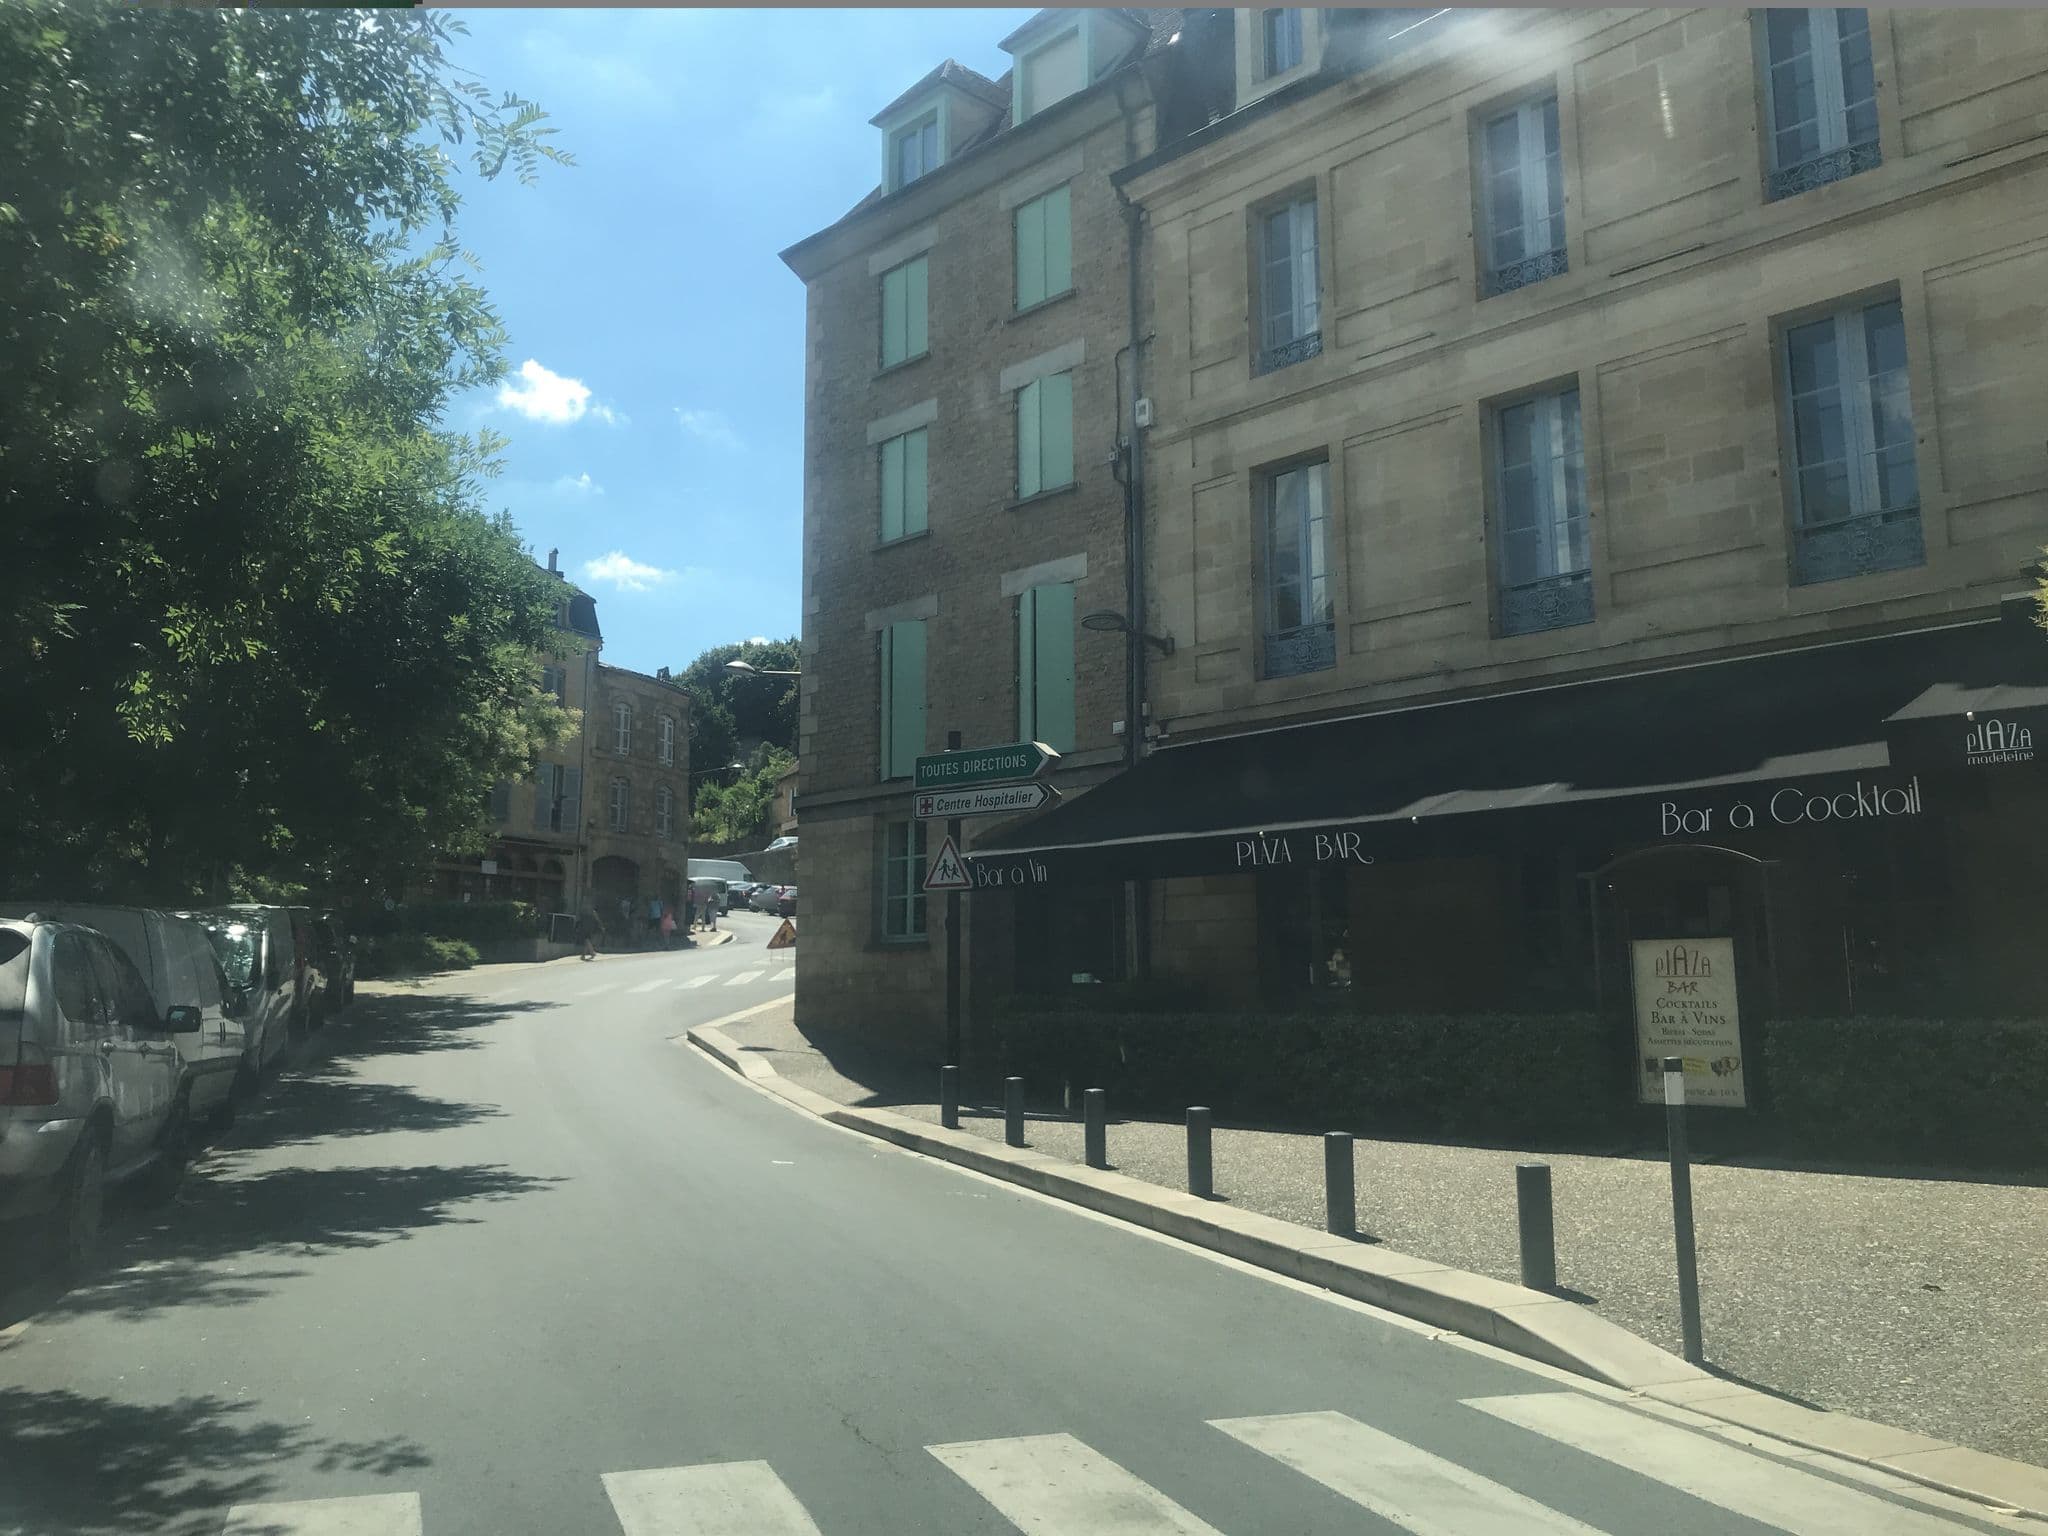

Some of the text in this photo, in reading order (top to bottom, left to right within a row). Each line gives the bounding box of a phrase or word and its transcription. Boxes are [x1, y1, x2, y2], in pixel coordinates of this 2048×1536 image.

[920, 754, 1027, 778] TOUTES DIRECTIONS
[1967, 750, 2034, 766] madeleine
[936, 793, 1033, 812] Centre Hospitalier
[1661, 775, 1922, 836] Bar à Cocktail
[1236, 831, 1375, 866] PLAZA BAR
[976, 863, 1003, 887] Bar
[1028, 858, 1048, 883] Vin
[1667, 981, 1699, 995] BAR
[1692, 1011, 1726, 1025] VINS
